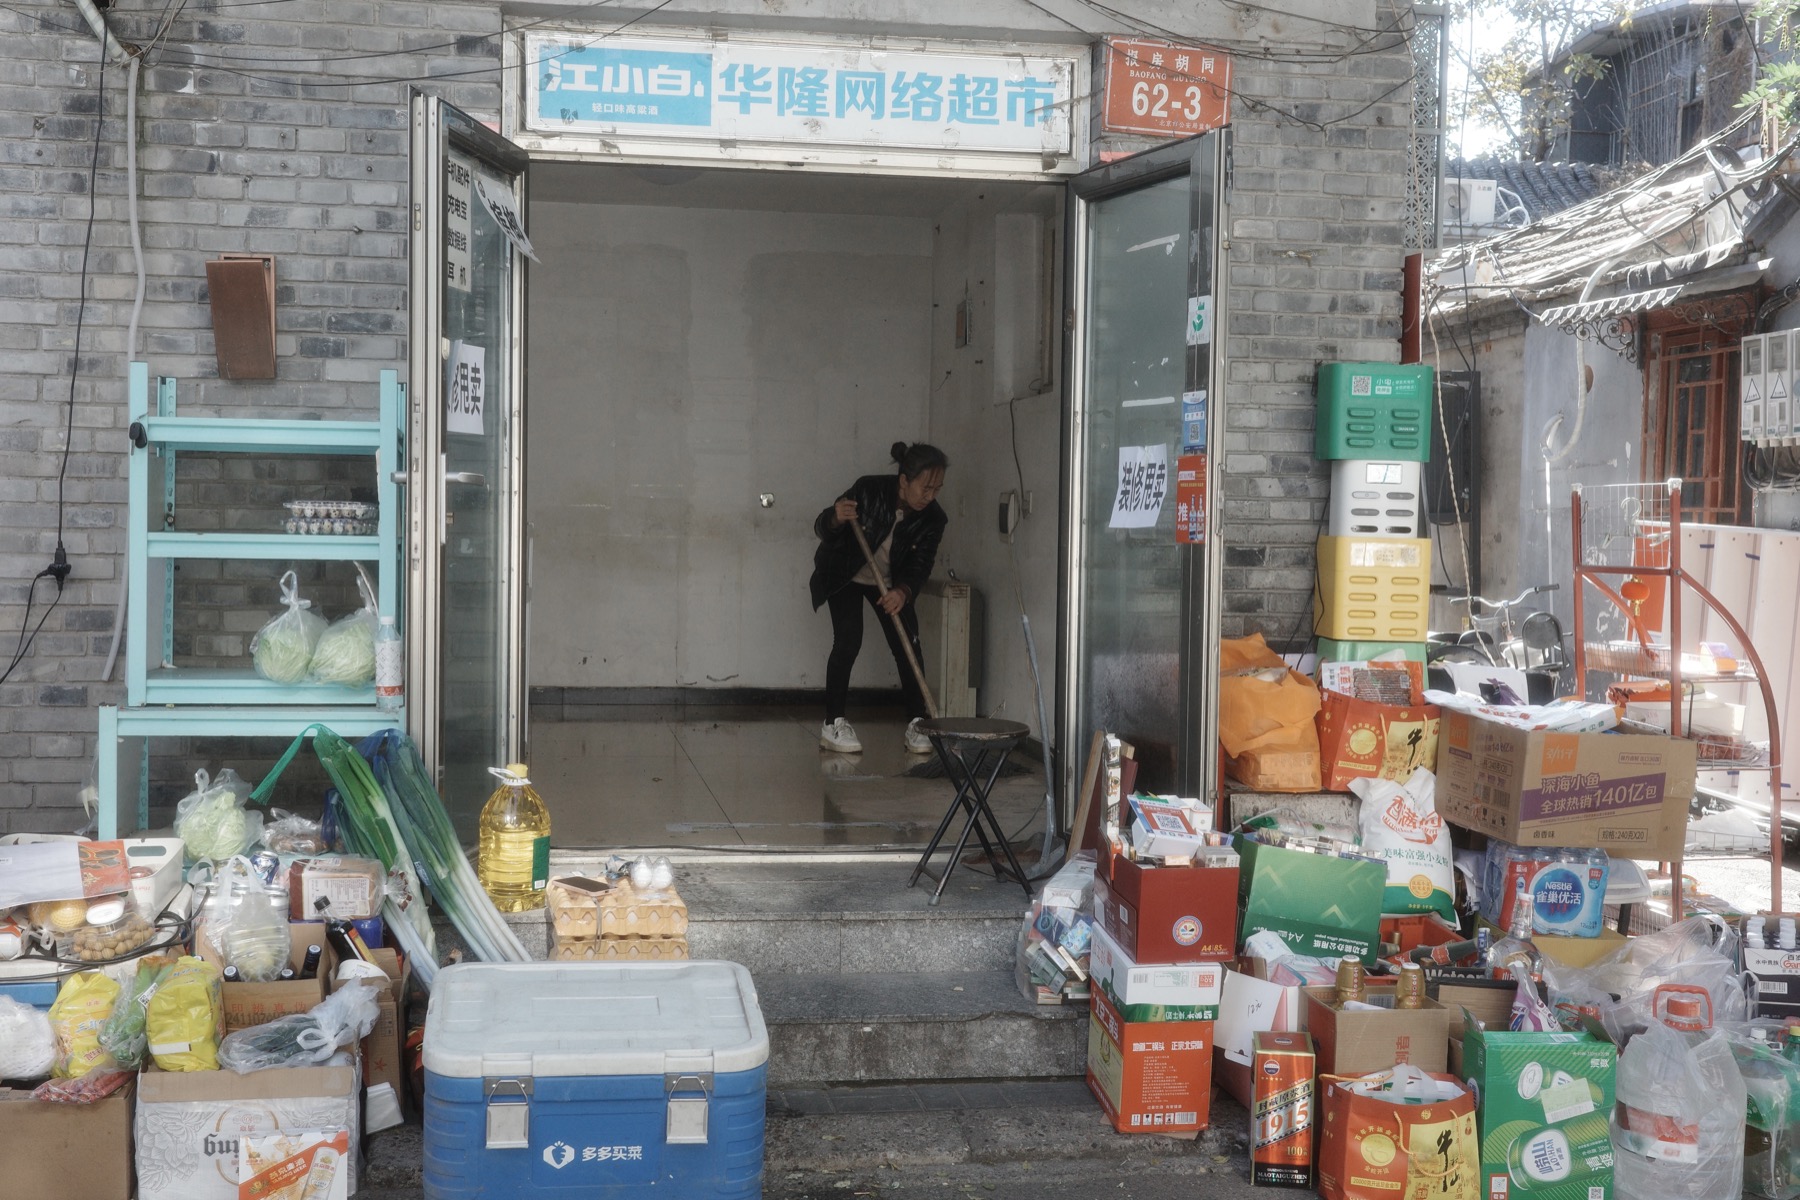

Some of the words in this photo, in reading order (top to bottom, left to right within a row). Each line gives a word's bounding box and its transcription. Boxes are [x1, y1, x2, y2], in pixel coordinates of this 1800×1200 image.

[1125, 48, 1215, 74] 报房胡同
[545, 59, 691, 96] 江小白
[1129, 70, 1167, 80] BAOFANG
[716, 62, 1057, 129] 华隆网络超市
[1132, 81, 1202, 121] 62-3
[1119, 460, 1166, 512] 装修甩卖
[1178, 502, 1188, 522] 推
[1541, 772, 1600, 795] 深海小鱼
[1540, 783, 1657, 814] 全球热销140亿包
[1533, 830, 1555, 839] 卤香味
[1383, 847, 1449, 868] 美味富强小麦粉
[1536, 891, 1581, 905] 雀巢优活
[1201, 944, 1212, 952] A4
[1288, 931, 1304, 943] A4
[1313, 939, 1369, 956] 多功能办公用纸
[1258, 1081, 1311, 1114] 封藏原浆酒
[1258, 1102, 1309, 1141] 1915
[582, 1145, 643, 1162] 多多买菜
[1531, 1140, 1554, 1175] 崂山
[1546, 1139, 1562, 1171] LAOSHAN
[269, 1157, 306, 1180] 燕京啤酒
[1257, 1171, 1308, 1180] MAOTAIGUZHEN
